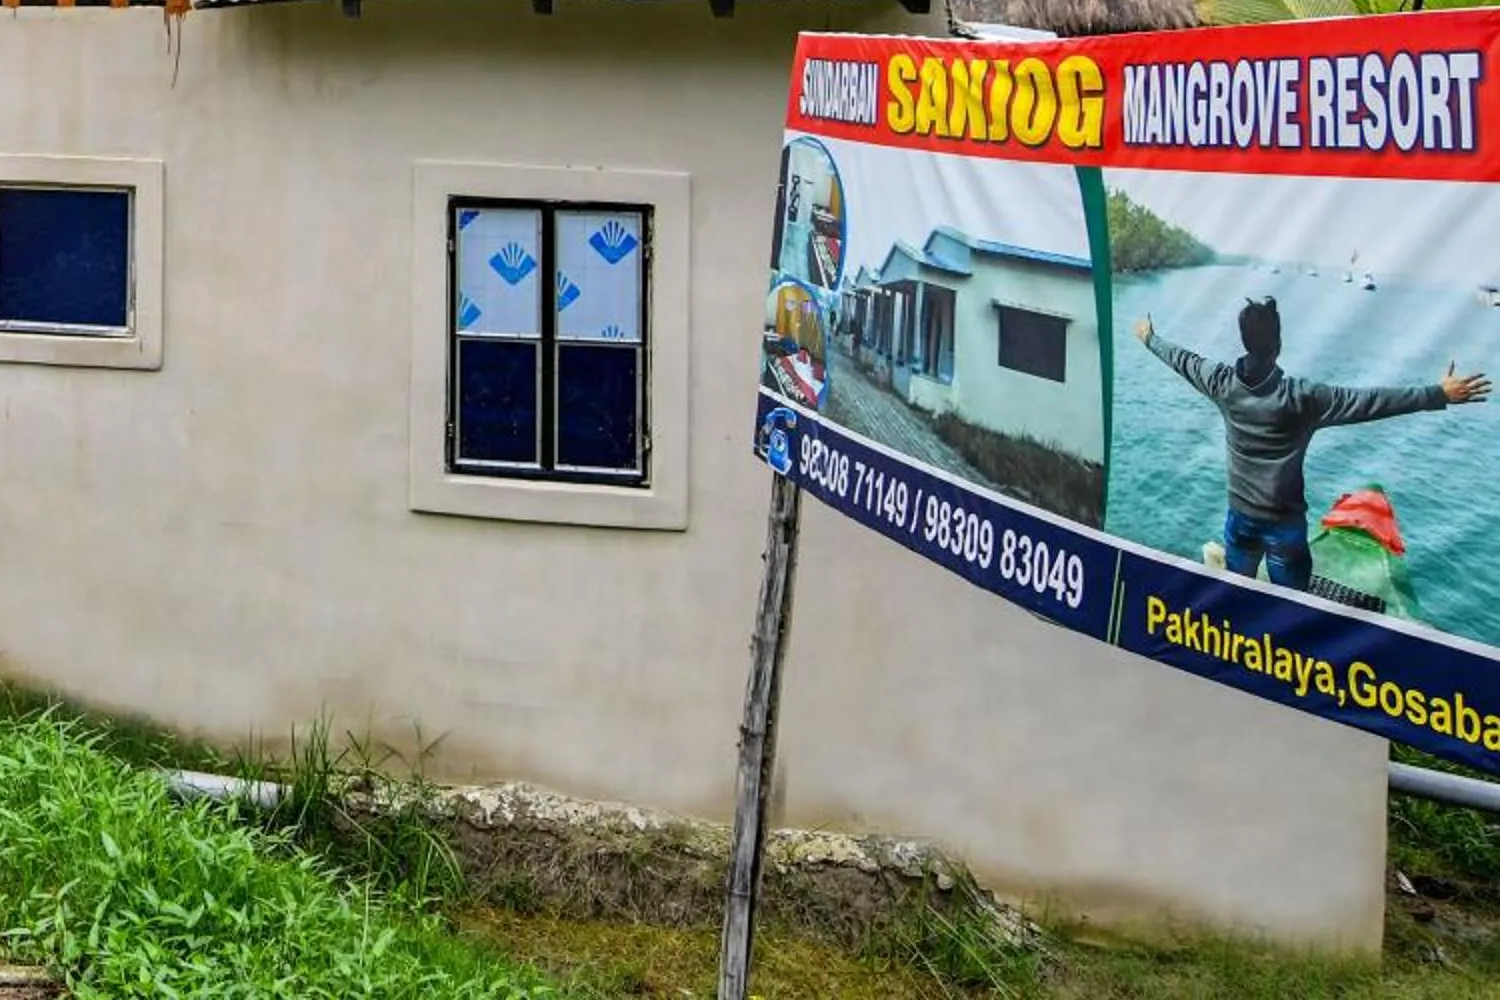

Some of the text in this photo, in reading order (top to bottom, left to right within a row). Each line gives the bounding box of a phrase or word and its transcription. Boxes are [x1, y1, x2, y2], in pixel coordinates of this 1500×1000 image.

[887, 53, 1104, 148] SANJOG
[1123, 58, 1301, 148] MANGROVE
[1308, 51, 1480, 151] RESORT
[853, 462, 908, 527] 71149
[924, 495, 993, 569] 98309
[1000, 529, 1084, 609] 83049
